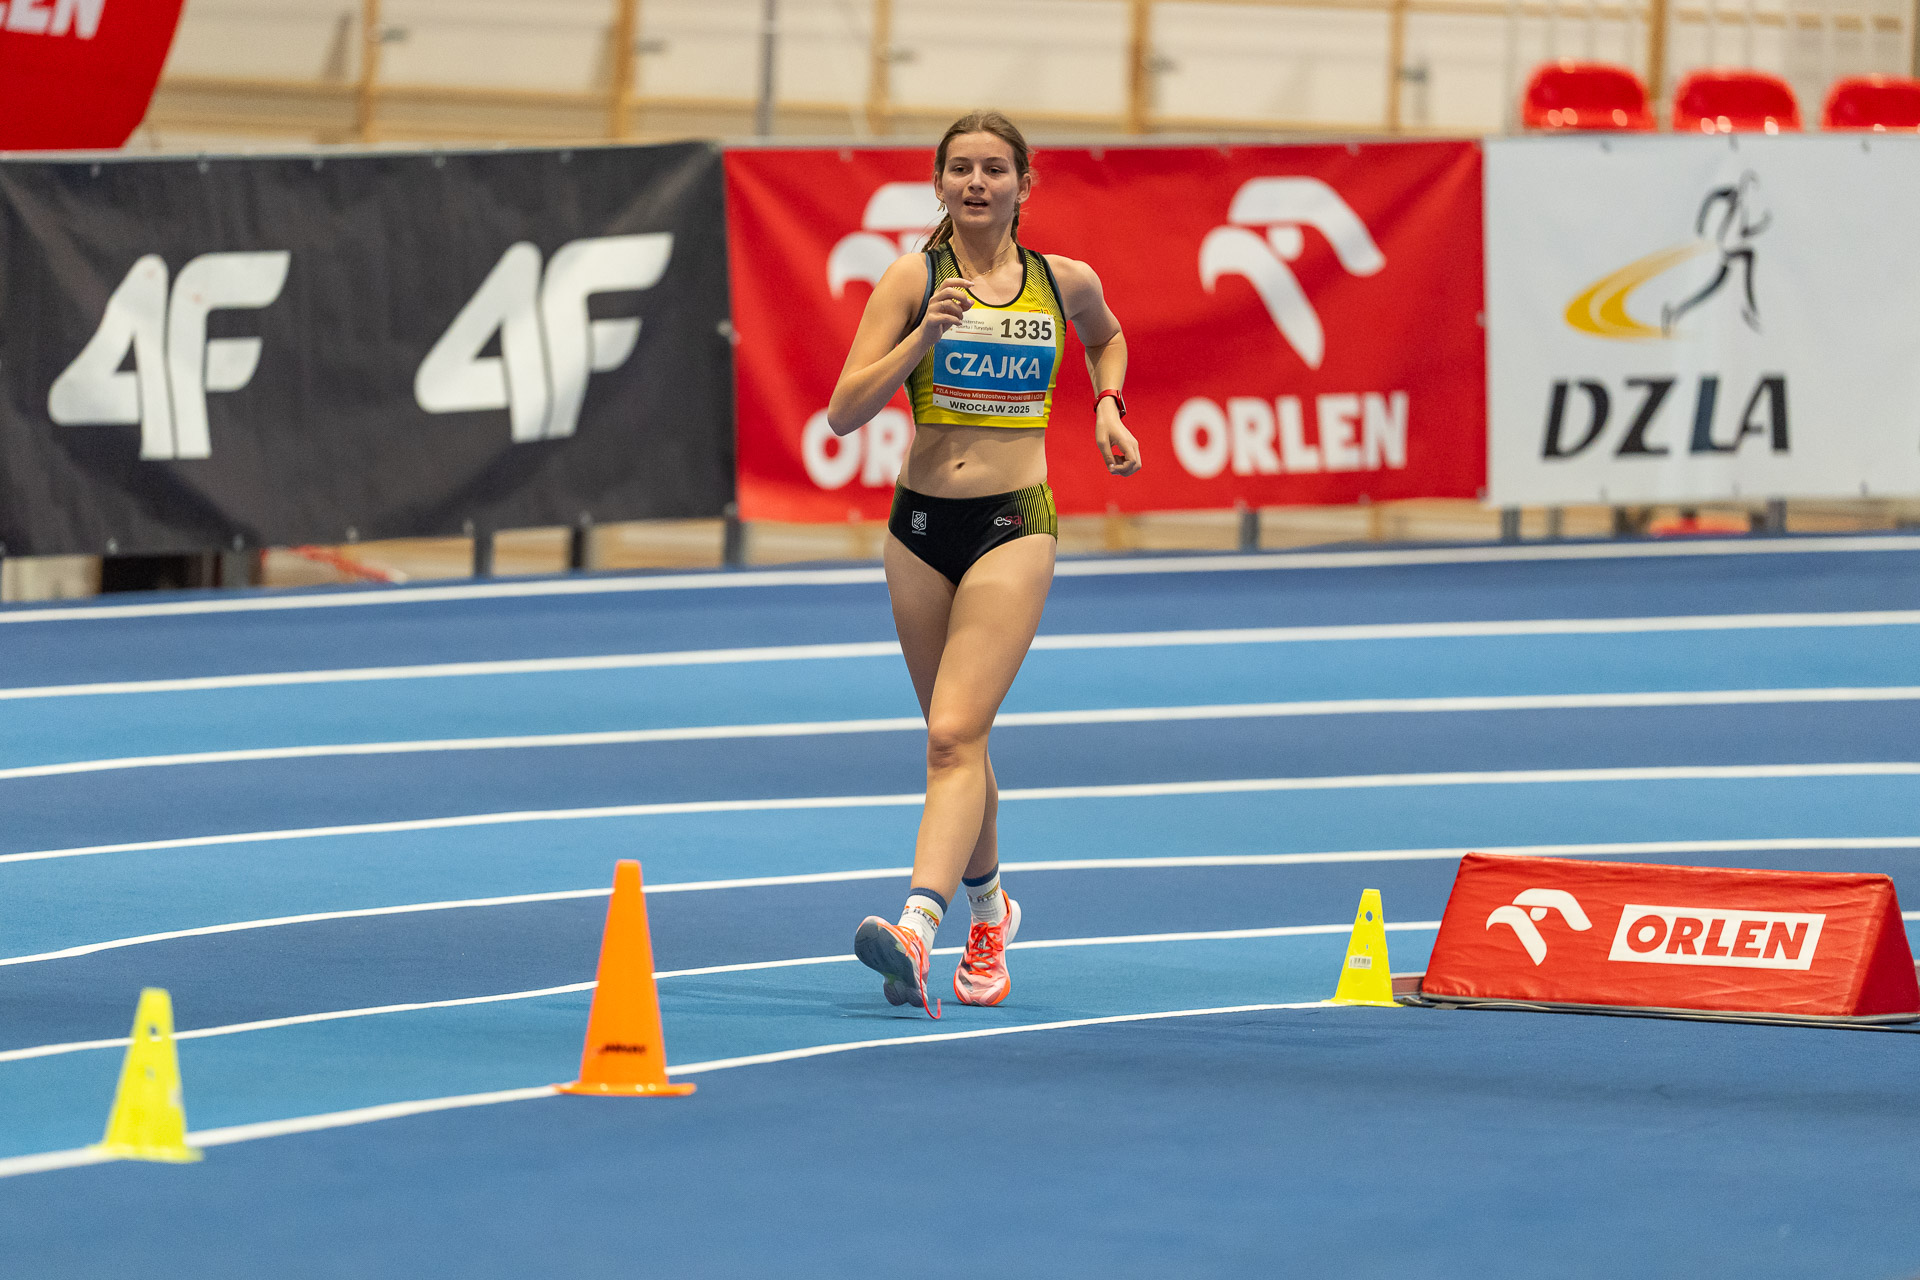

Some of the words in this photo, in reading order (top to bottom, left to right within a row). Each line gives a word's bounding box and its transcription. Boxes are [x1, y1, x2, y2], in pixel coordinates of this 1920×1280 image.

[414, 233, 673, 443] 4F
[1000, 318, 1052, 340] 1335
[48, 251, 290, 460] 4F
[945, 352, 1041, 379] CZAJKA
[950, 390, 971, 398] Halowe
[972, 392, 1006, 400] Mistrzostwa
[950, 400, 1006, 413] WROCŁAW
[1008, 406, 1030, 414] 2025
[1540, 373, 1790, 459] DZLA
[1170, 390, 1410, 480] ORLEN
[1626, 914, 1810, 960] ORLEN
